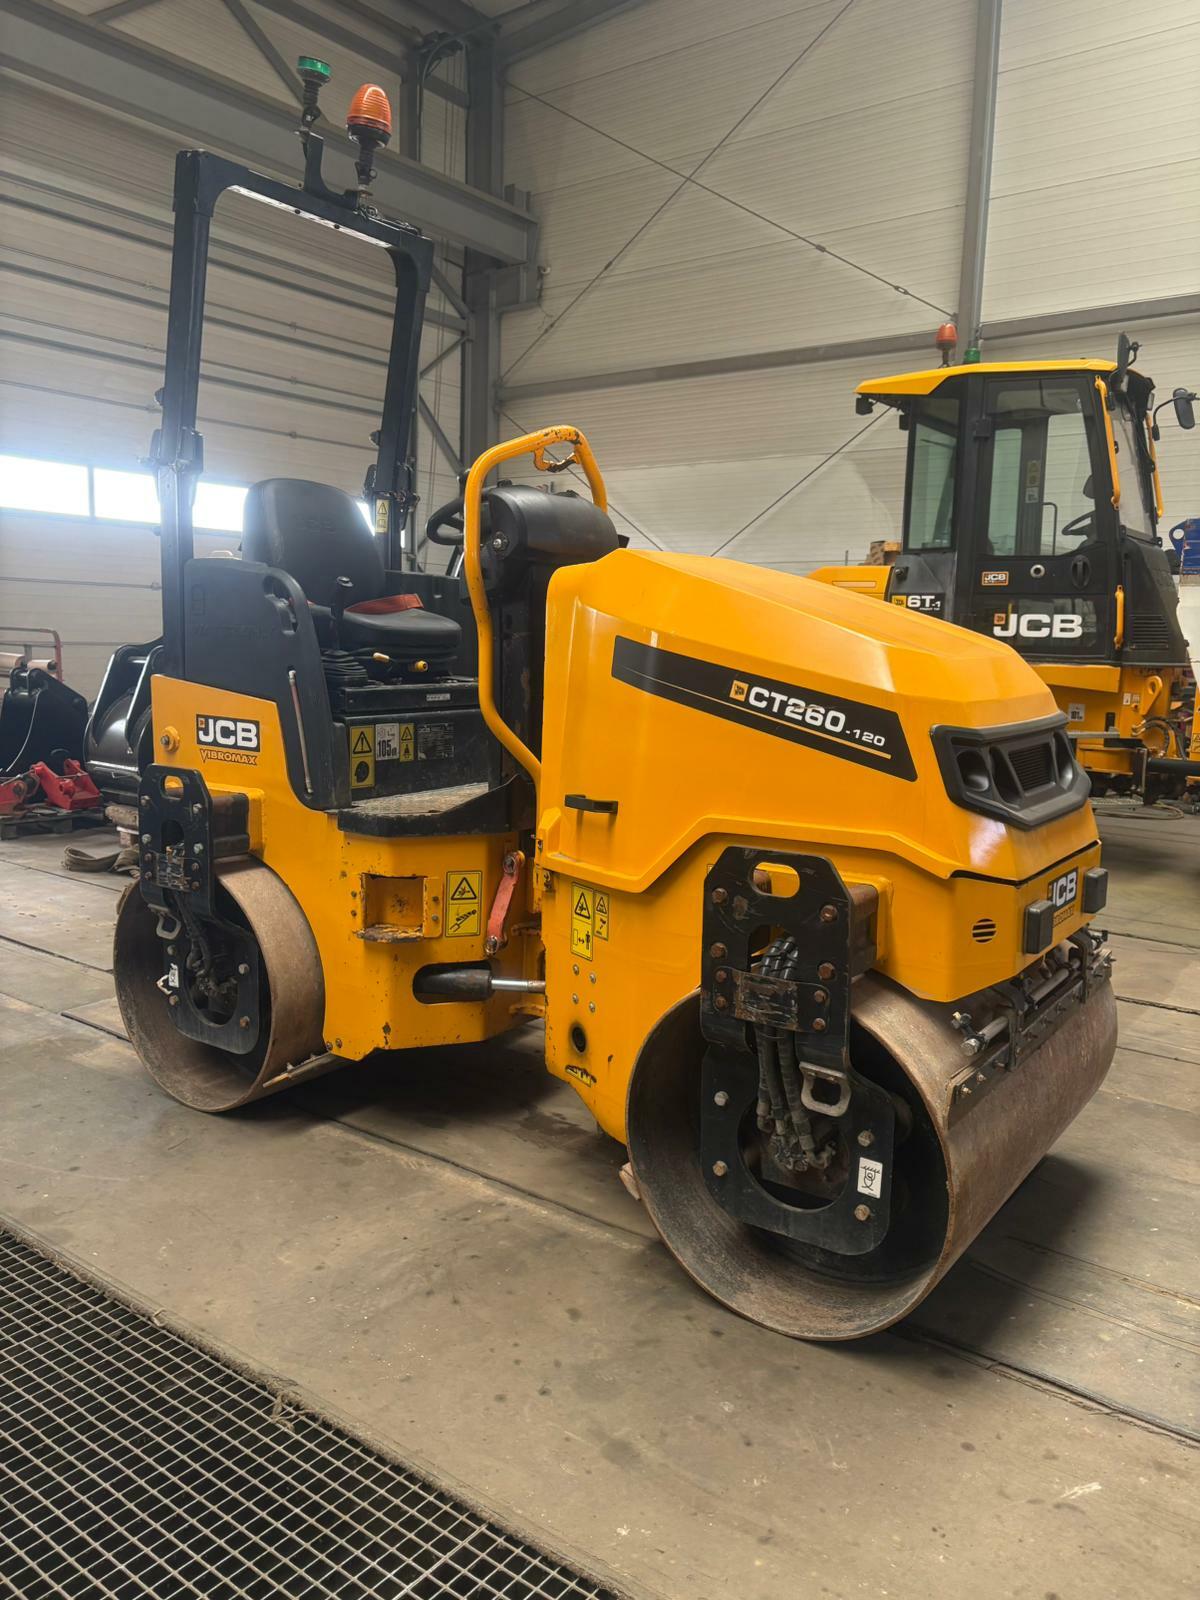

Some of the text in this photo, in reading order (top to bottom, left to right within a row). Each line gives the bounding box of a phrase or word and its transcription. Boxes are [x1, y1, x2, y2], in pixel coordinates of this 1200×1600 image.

[993, 614, 1083, 638] JCB
[198, 718, 258, 748] JCB
[200, 748, 258, 766] VIBROMAX
